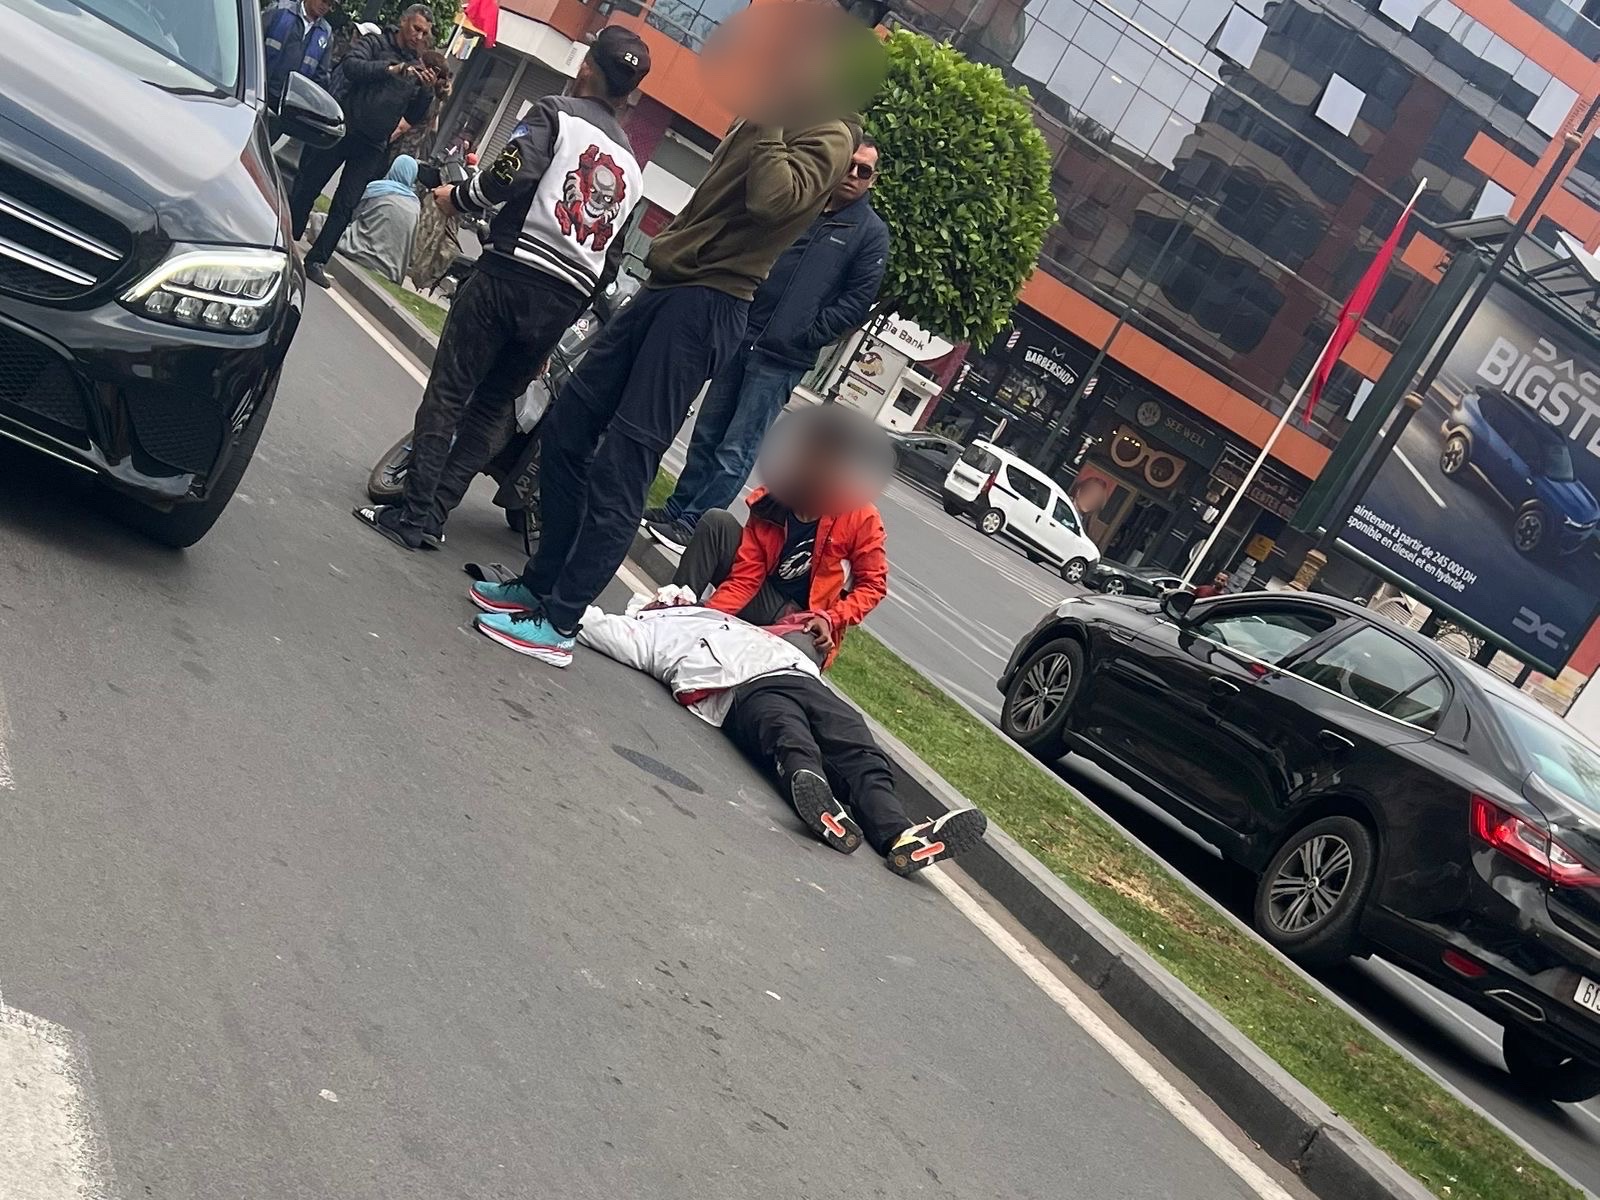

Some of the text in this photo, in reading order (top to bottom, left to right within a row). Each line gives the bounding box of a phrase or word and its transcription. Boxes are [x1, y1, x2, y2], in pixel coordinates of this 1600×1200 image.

[624, 52, 639, 66] 23
[898, 329, 925, 351] Bank
[1024, 350, 1075, 386] BARBERSHOP
[1164, 416, 1206, 448] SEE WELL
[1346, 515, 1466, 593] sponible en diesel et en hybride
[1353, 504, 1478, 585] aintenant à partir de 245 000 DH
[1582, 983, 1600, 1011] 61
